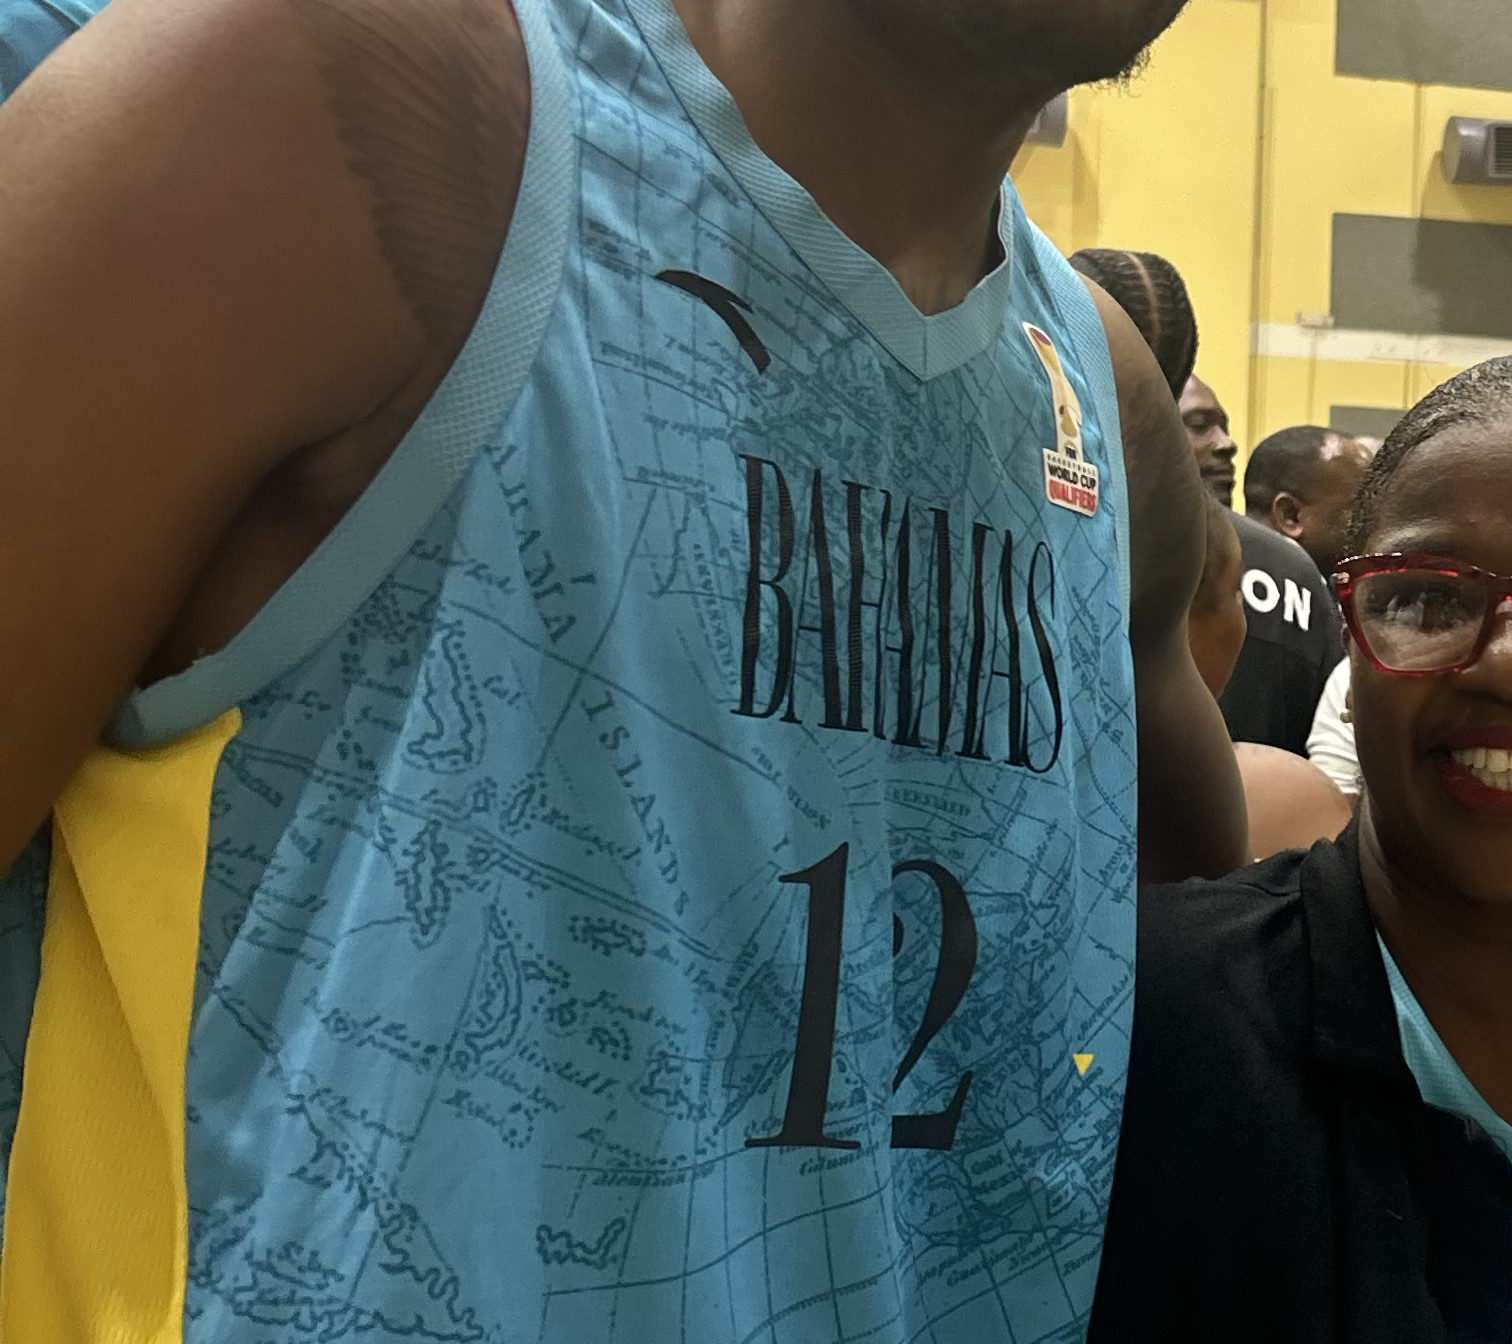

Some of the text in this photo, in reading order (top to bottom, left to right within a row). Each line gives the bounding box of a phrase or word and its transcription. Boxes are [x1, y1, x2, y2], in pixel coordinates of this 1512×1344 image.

[1048, 462, 1096, 491] WORLD CUP
[730, 453, 1065, 775] BAHAMAS
[1241, 568, 1312, 632] ON
[744, 840, 979, 1150] 12
